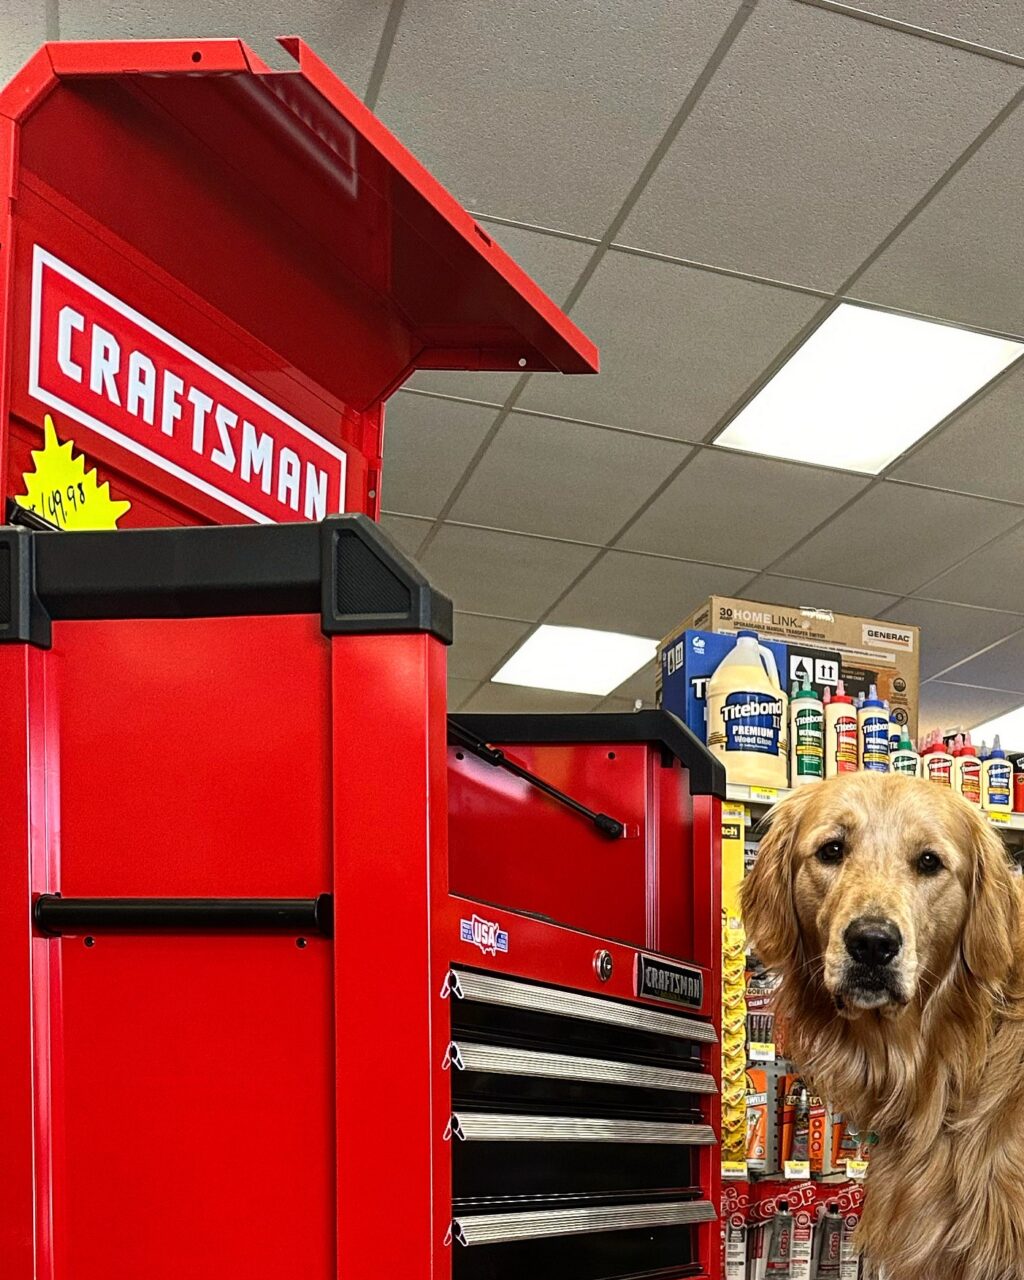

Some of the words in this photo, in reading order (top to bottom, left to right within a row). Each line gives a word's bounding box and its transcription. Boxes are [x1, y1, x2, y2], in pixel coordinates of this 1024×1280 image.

[57, 305, 327, 520] CRAFTSMAN
[719, 608, 733, 617] 30
[733, 609, 798, 628] HOMELINK
[867, 629, 911, 642] GENERAC
[721, 700, 782, 721] Titebond
[733, 725, 773, 738] PREMIUM
[735, 735, 755, 745] Wood
[475, 921, 495, 946] USA
[645, 966, 700, 999] CRAFTSMAN
